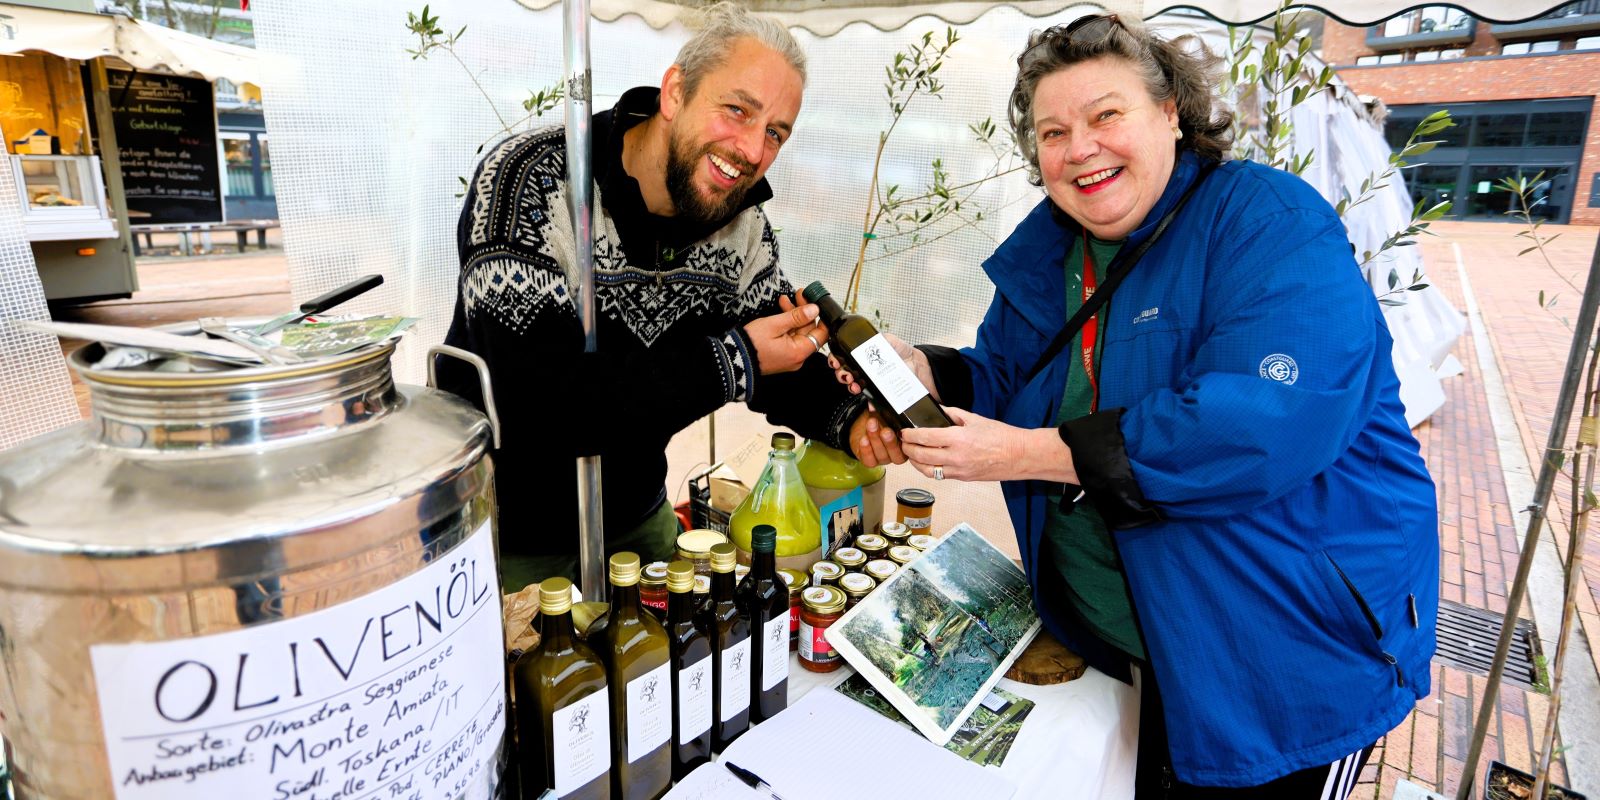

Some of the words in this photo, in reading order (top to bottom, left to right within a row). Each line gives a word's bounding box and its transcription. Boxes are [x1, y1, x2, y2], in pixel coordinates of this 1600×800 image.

[155, 557, 488, 723] OLIVENÖL
[123, 747, 255, 786] Anbaugebiet:
[270, 717, 369, 774] Monte
[383, 673, 448, 727] Amiata
[155, 731, 232, 759] Sorte:
[245, 703, 352, 742] Olivastra
[363, 645, 453, 705] Seggianese
[377, 739, 432, 782] Ernte
